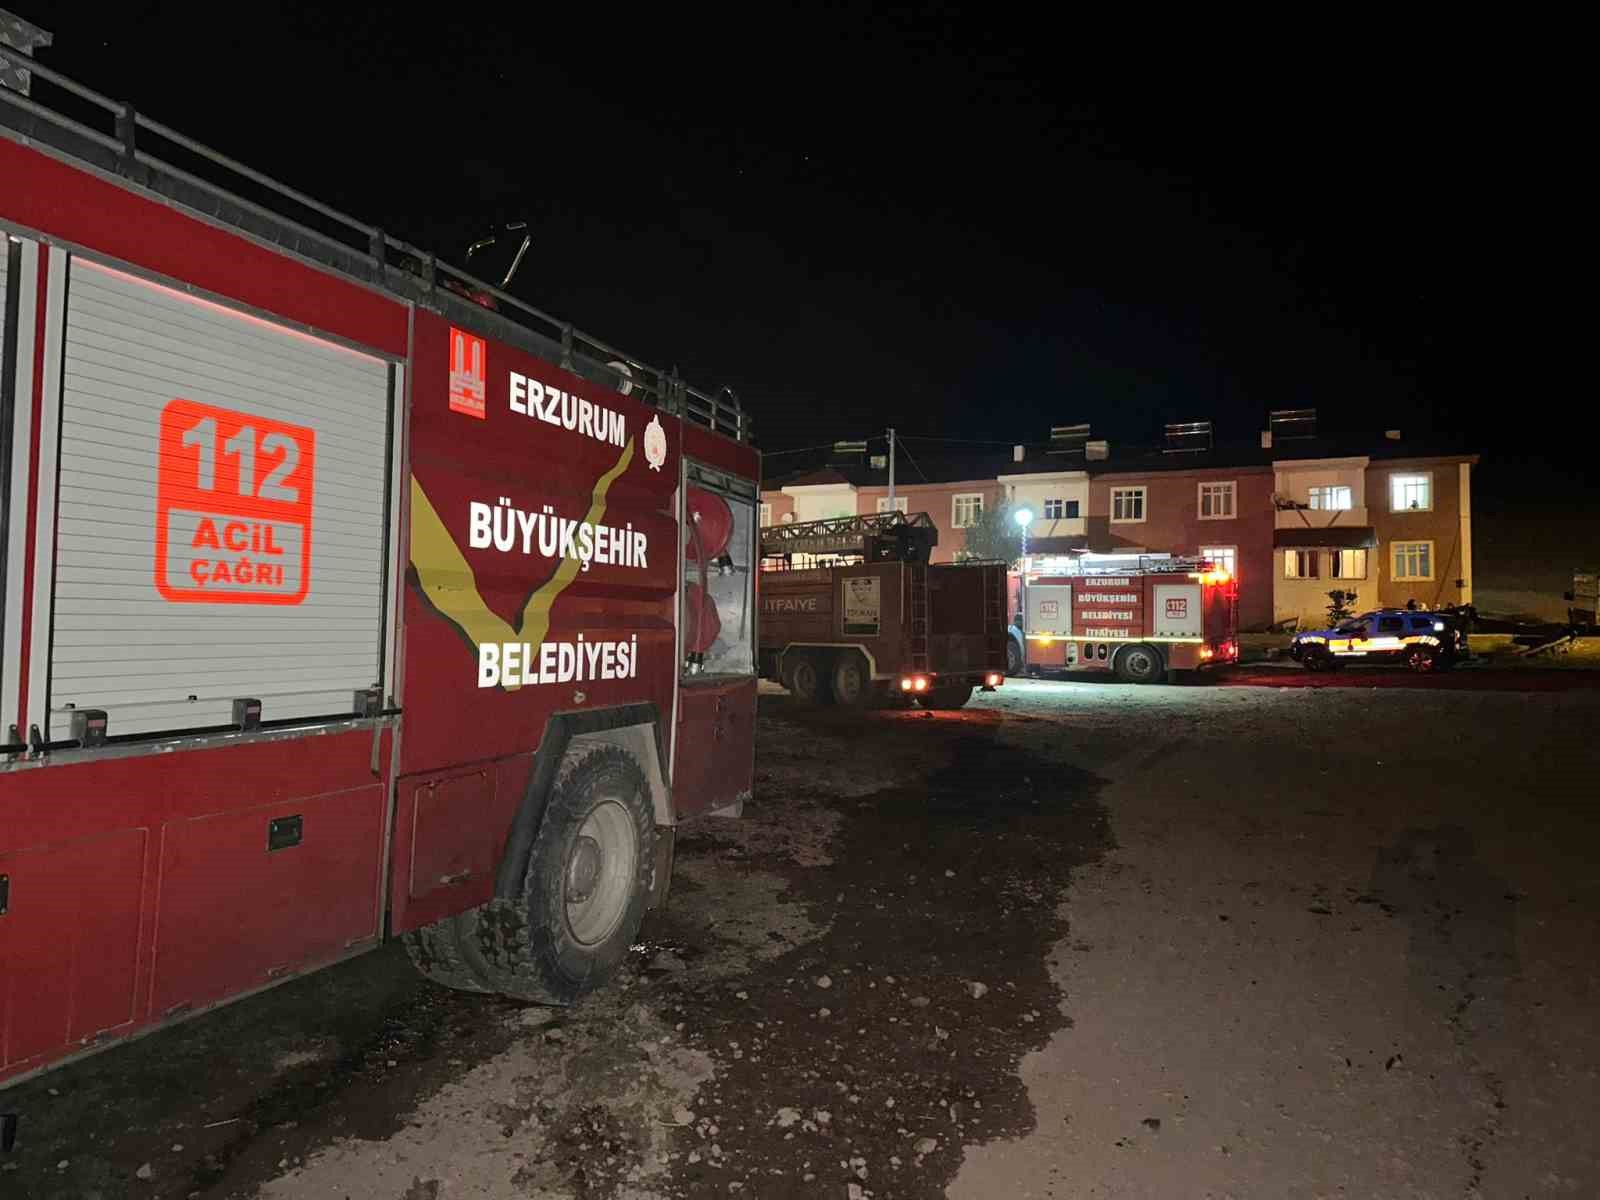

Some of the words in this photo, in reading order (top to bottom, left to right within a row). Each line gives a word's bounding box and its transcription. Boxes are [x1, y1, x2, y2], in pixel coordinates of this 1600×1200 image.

[509, 371, 626, 447] ERZURUM
[182, 416, 299, 503] 112
[190, 557, 284, 587] ÇAĞRI
[469, 496, 648, 572] BÜYÜKŞEHİR
[477, 633, 637, 688] BELEDİYESİ
